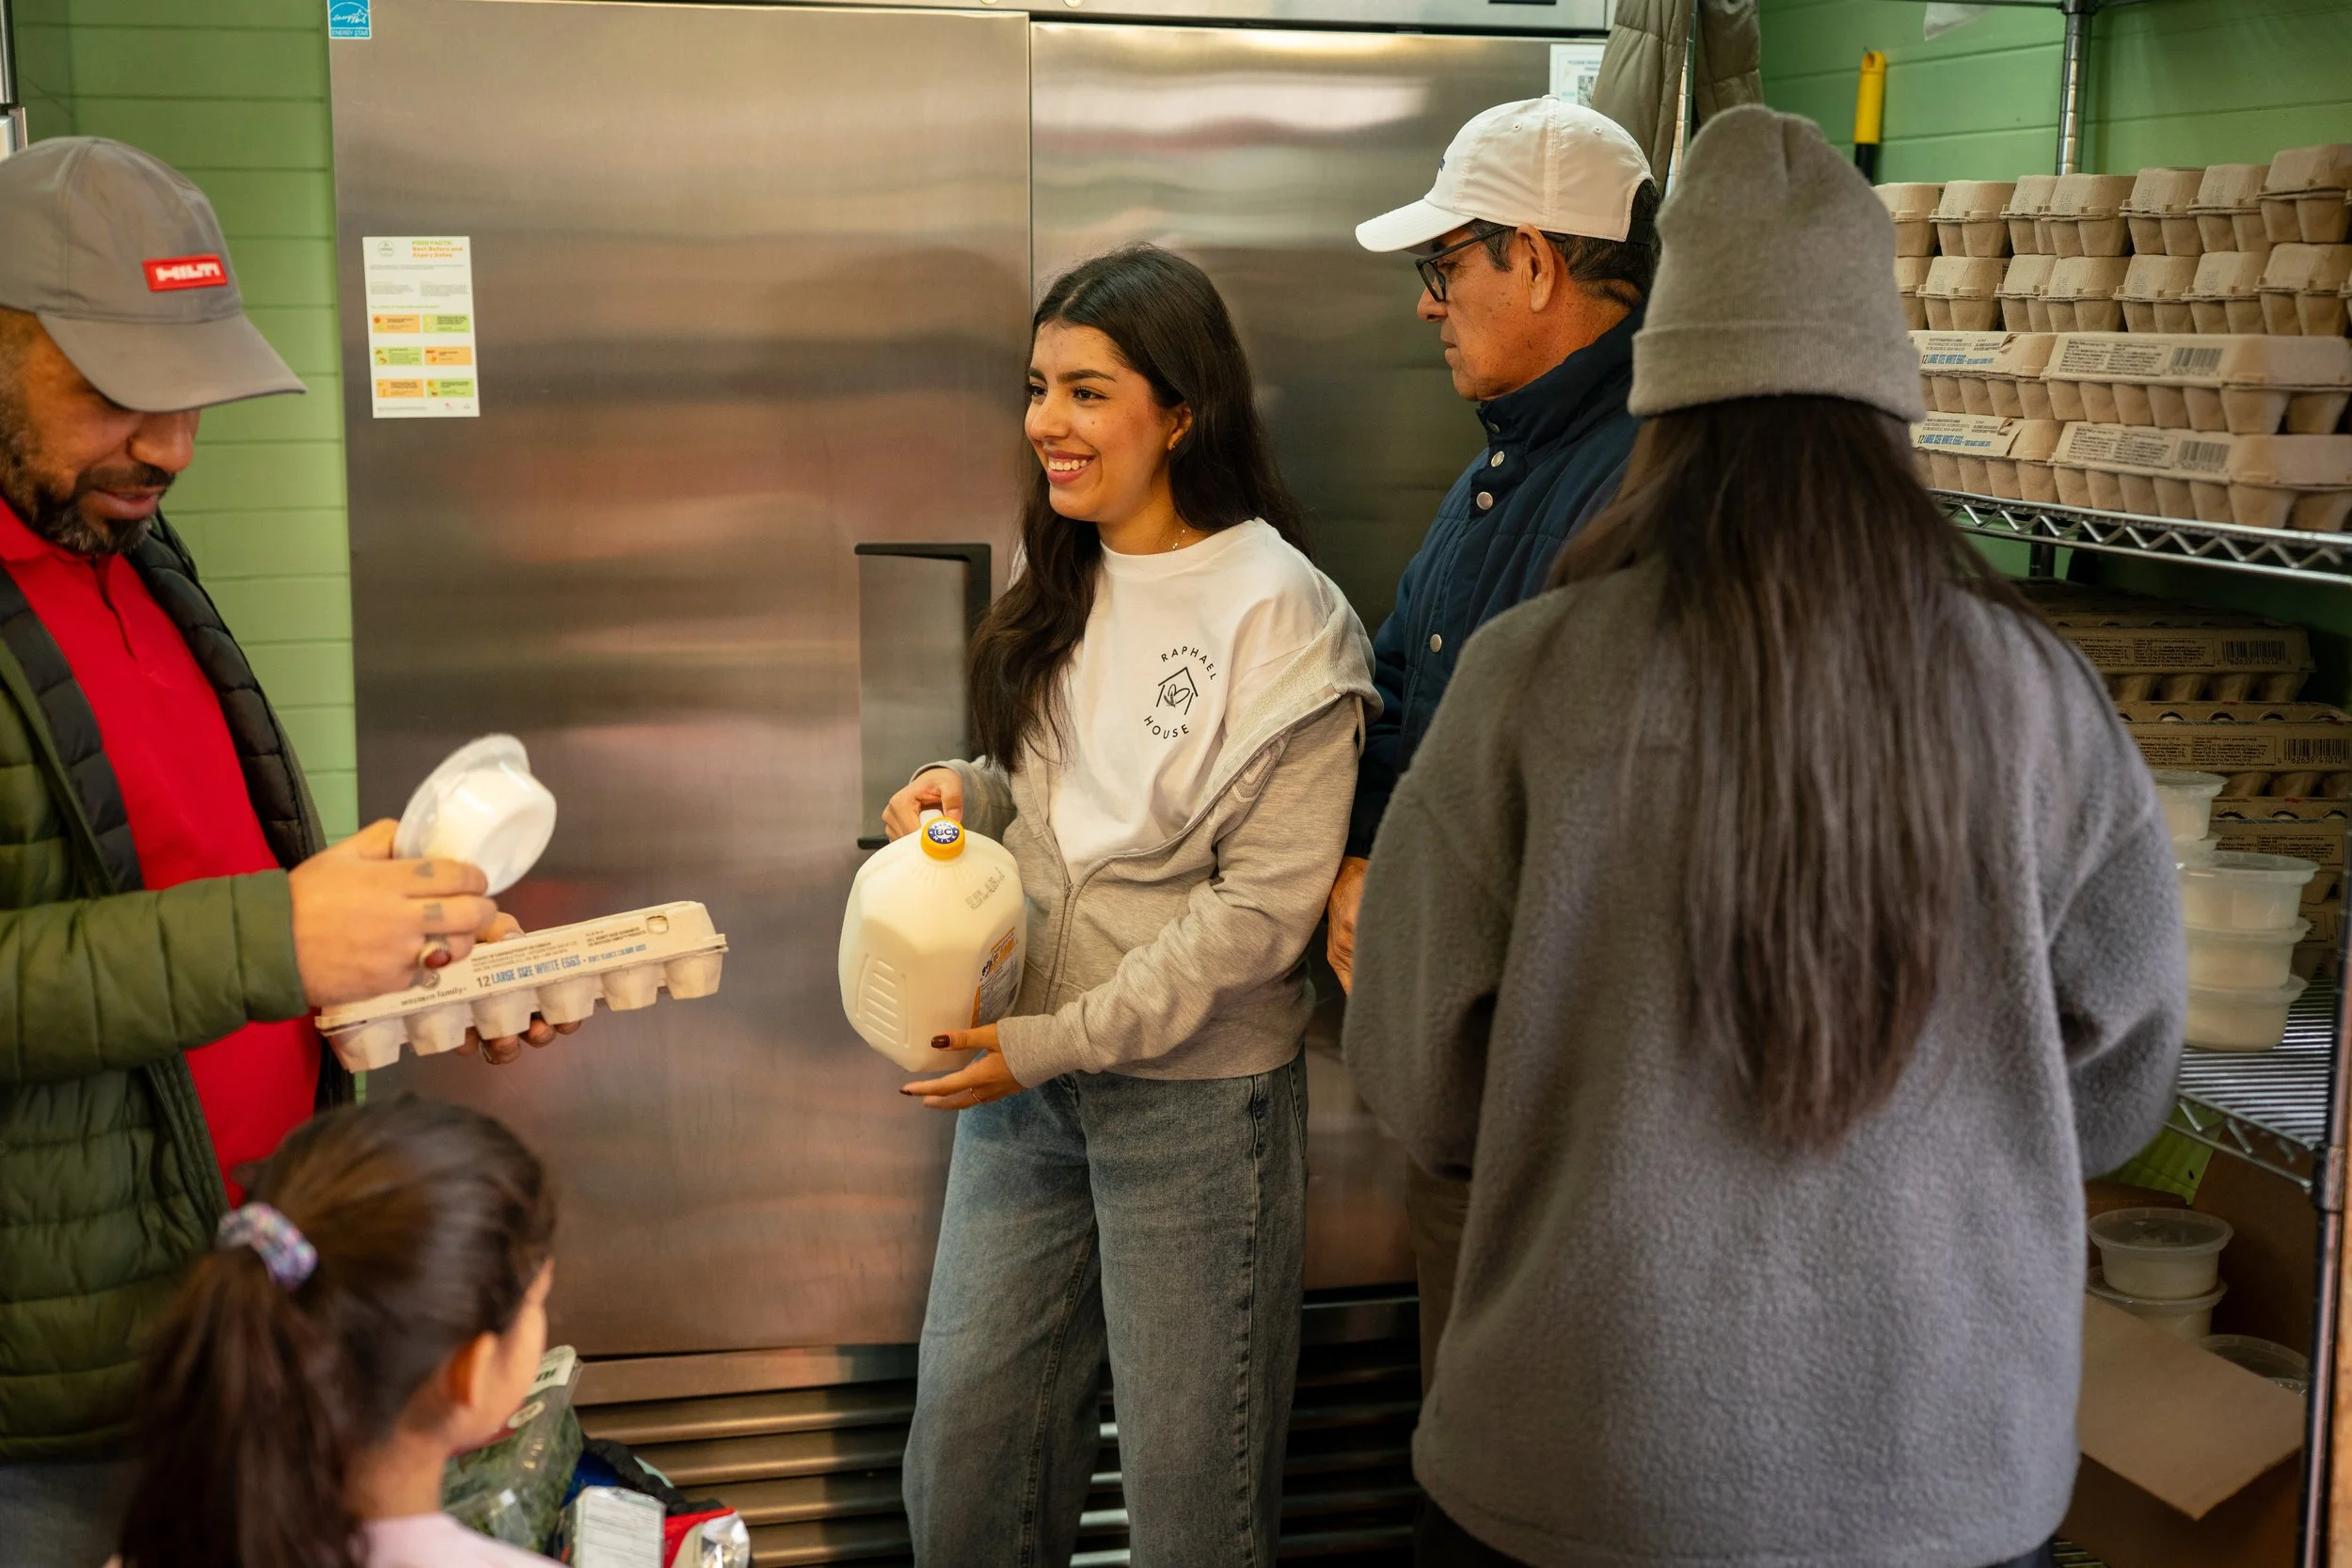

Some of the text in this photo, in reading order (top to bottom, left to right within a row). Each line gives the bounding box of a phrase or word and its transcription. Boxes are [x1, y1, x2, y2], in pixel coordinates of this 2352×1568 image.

[155, 262, 221, 281] HILTI
[1160, 645, 1217, 680] RAPHAEL
[1143, 715, 1189, 739] HOUSE
[935, 828, 952, 836] BC
[476, 975, 491, 989] 12
[490, 969, 516, 984] LARGE
[516, 965, 533, 979] SIZE
[534, 959, 560, 974] WHITE
[561, 955, 581, 969] EGGS
